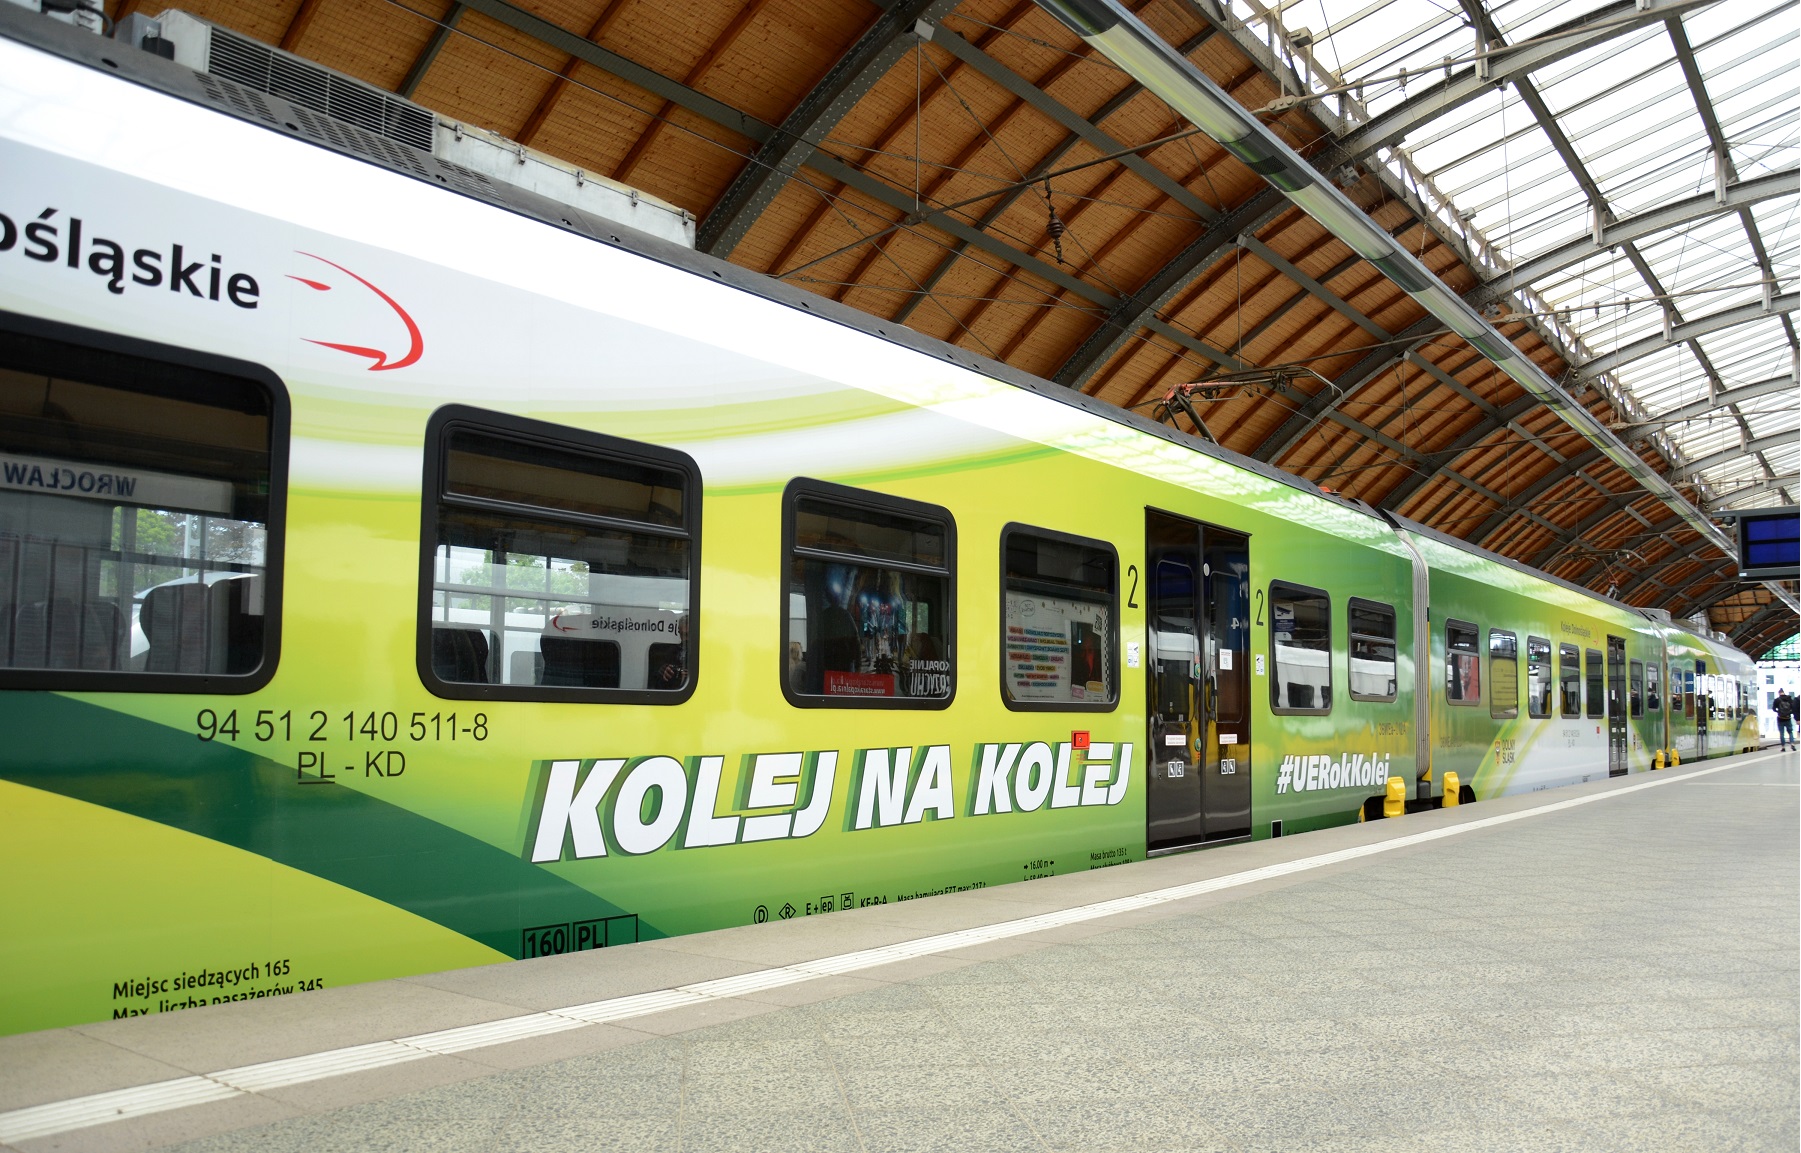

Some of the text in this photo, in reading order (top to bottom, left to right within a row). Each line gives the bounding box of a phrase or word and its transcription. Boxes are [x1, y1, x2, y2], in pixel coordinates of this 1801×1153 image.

[1127, 564, 1139, 609] 2
[1255, 588, 1264, 626] 2
[196, 708, 489, 742] 94 51 2 140 511-8
[297, 751, 336, 780] PL
[365, 750, 406, 778] KD
[1275, 752, 1391, 794] #UERokKolei
[522, 741, 1134, 864] KOLEJ NA KOLEJ
[527, 924, 603, 958] 160 PL
[112, 959, 290, 999] Miejsc siedzących 165
